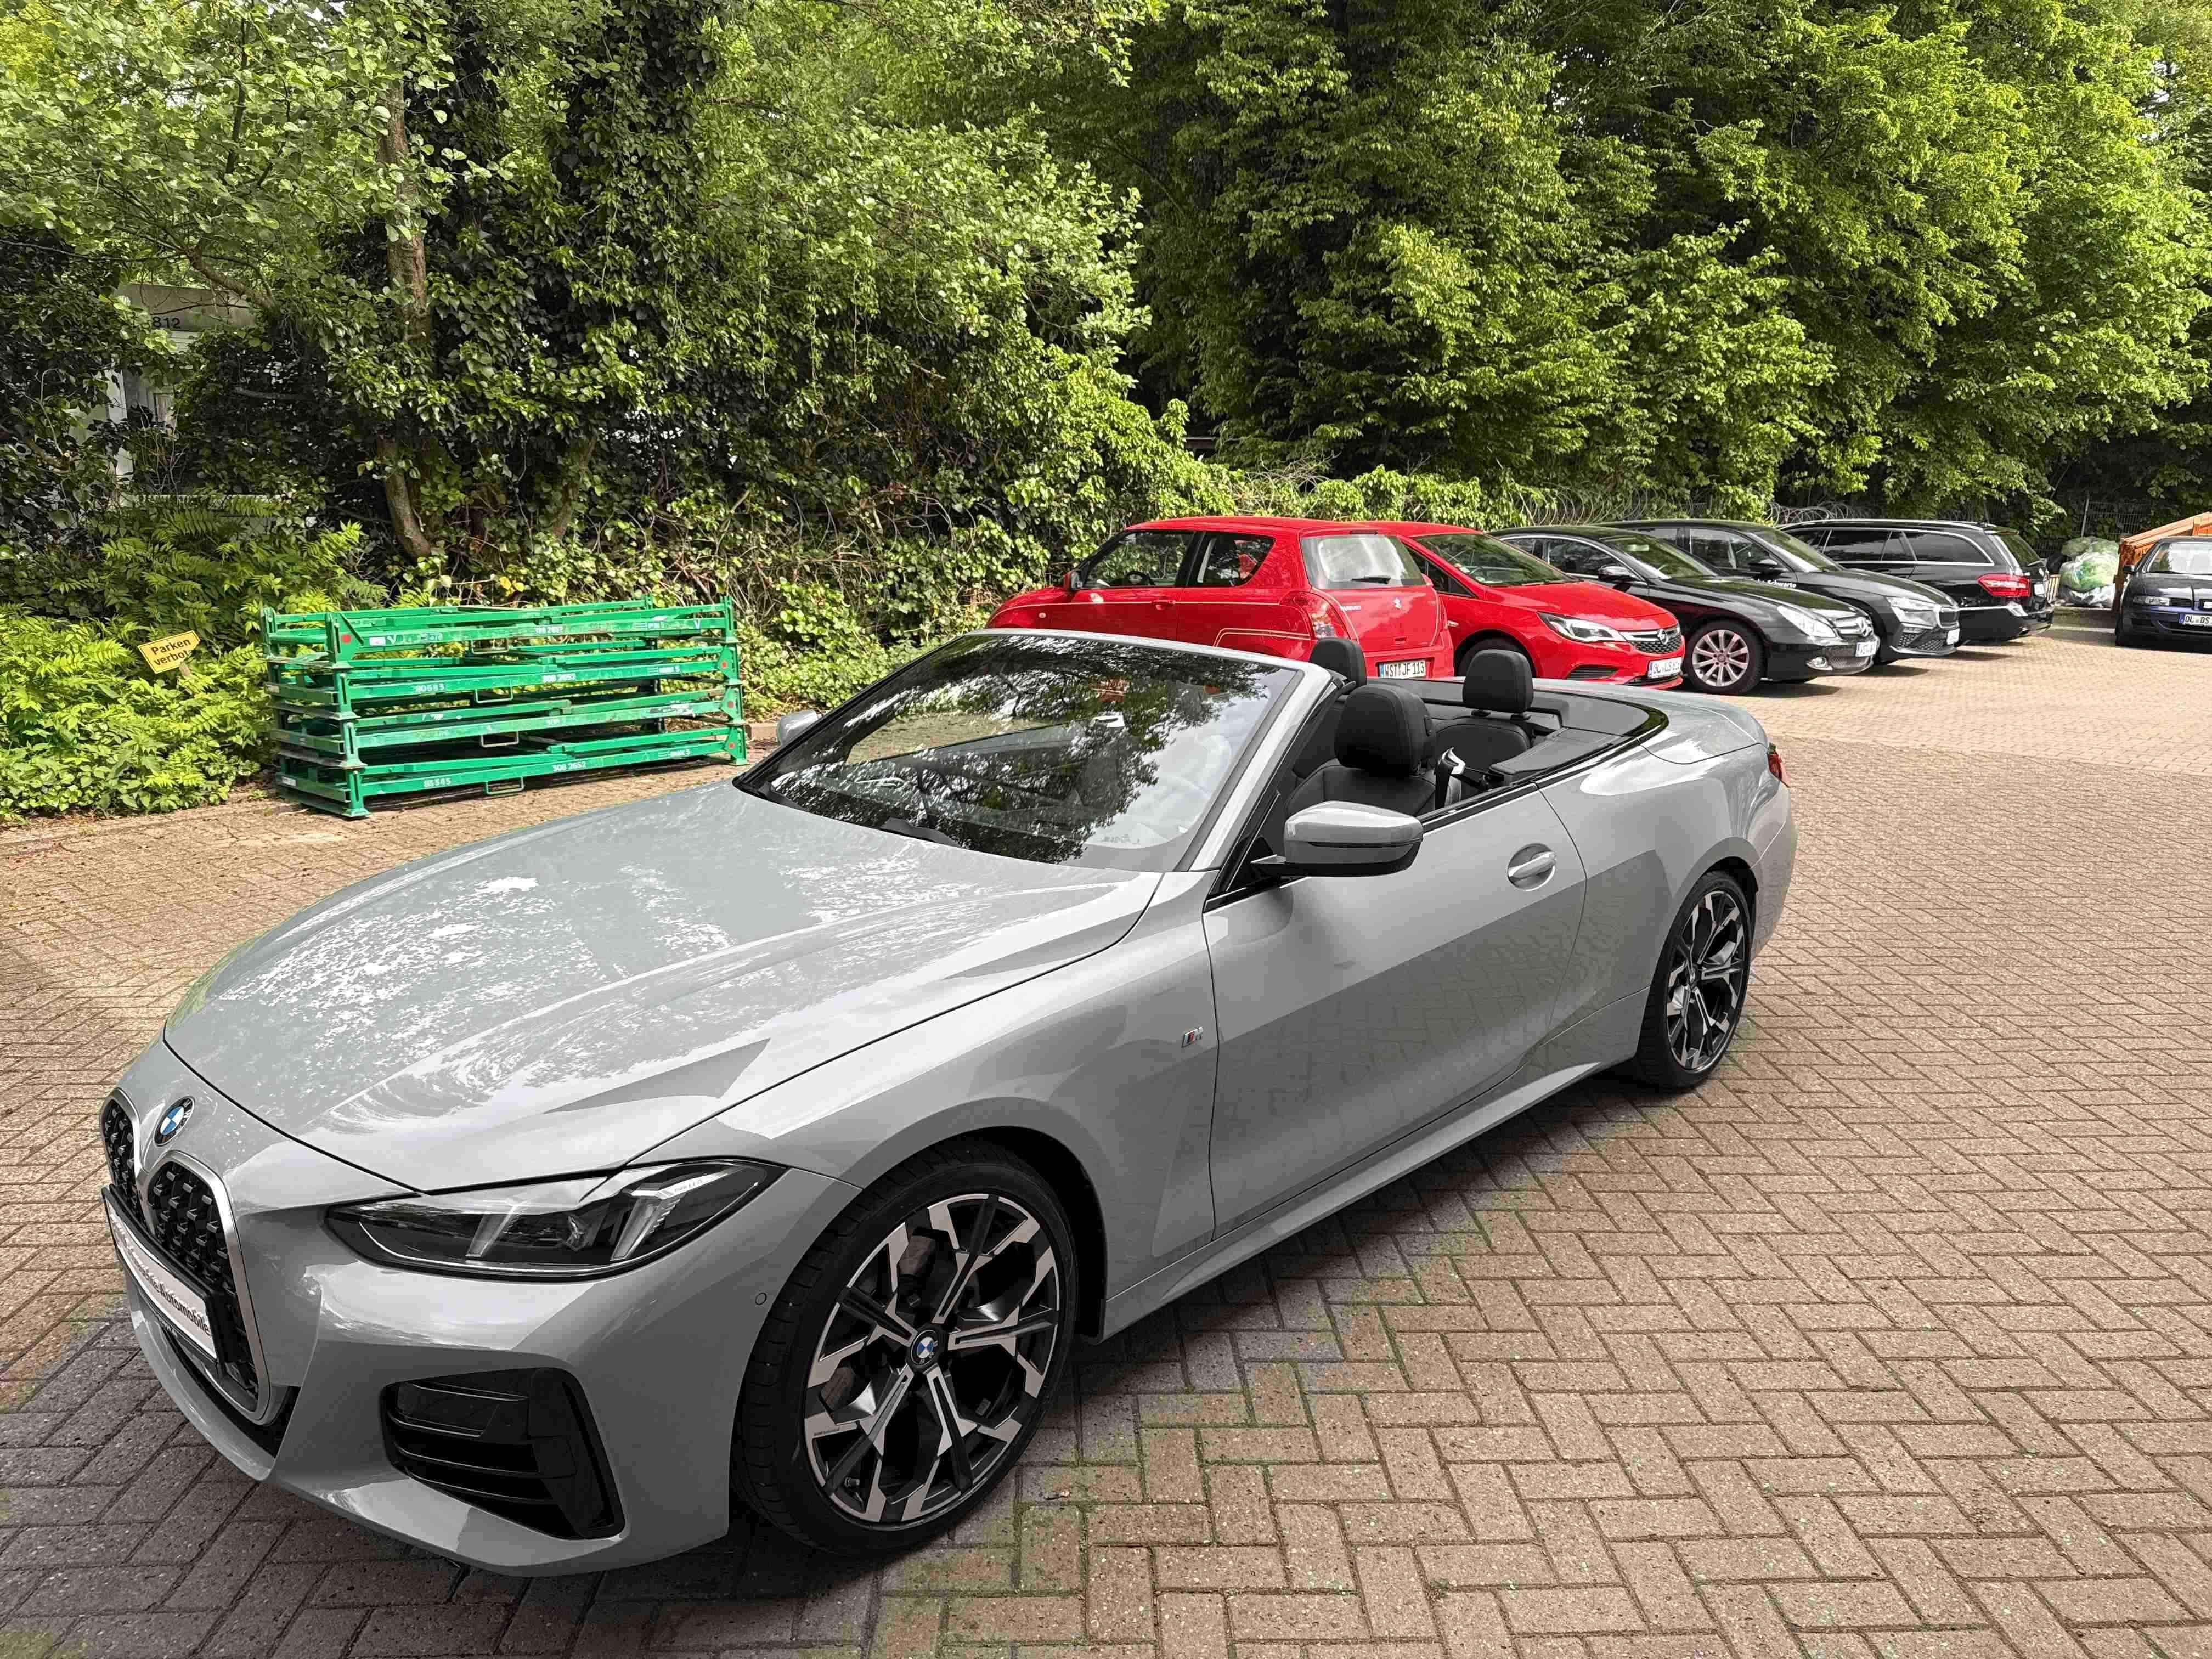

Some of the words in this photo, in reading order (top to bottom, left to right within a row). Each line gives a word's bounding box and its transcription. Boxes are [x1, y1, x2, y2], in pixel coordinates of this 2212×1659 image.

[153, 316, 180, 329] 812
[150, 639, 191, 656] Parken
[1385, 664, 1398, 677] WST
[1402, 662, 1410, 675] JF
[1413, 661, 1424, 674] 113
[159, 1283, 211, 1336] Automobile
